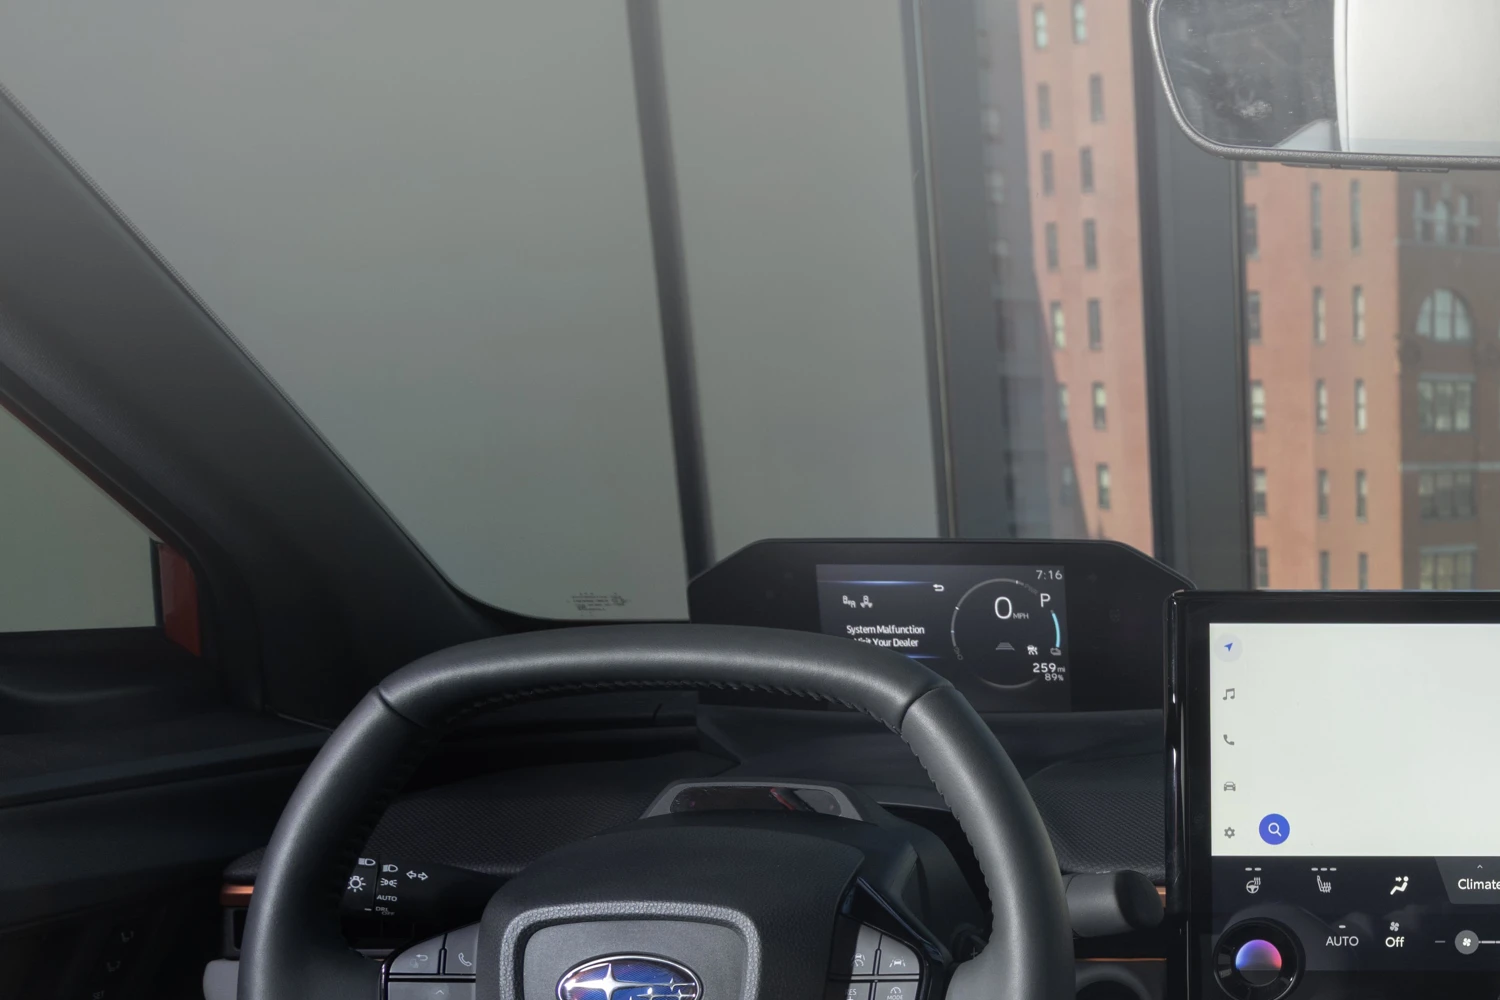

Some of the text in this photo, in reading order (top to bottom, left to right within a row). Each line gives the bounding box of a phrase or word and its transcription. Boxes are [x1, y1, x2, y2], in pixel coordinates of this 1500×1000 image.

[1036, 570, 1063, 580] 7:16
[1040, 593, 1051, 607] P
[994, 596, 1012, 619] 0
[846, 624, 925, 635] System Malfunction
[872, 638, 892, 647] Your
[893, 638, 919, 647] Dealer
[1033, 662, 1057, 673] 259
[1044, 673, 1064, 681] 89%
[376, 894, 398, 902] AUTO
[1325, 936, 1359, 947] AUTO
[1385, 936, 1405, 948] Off
